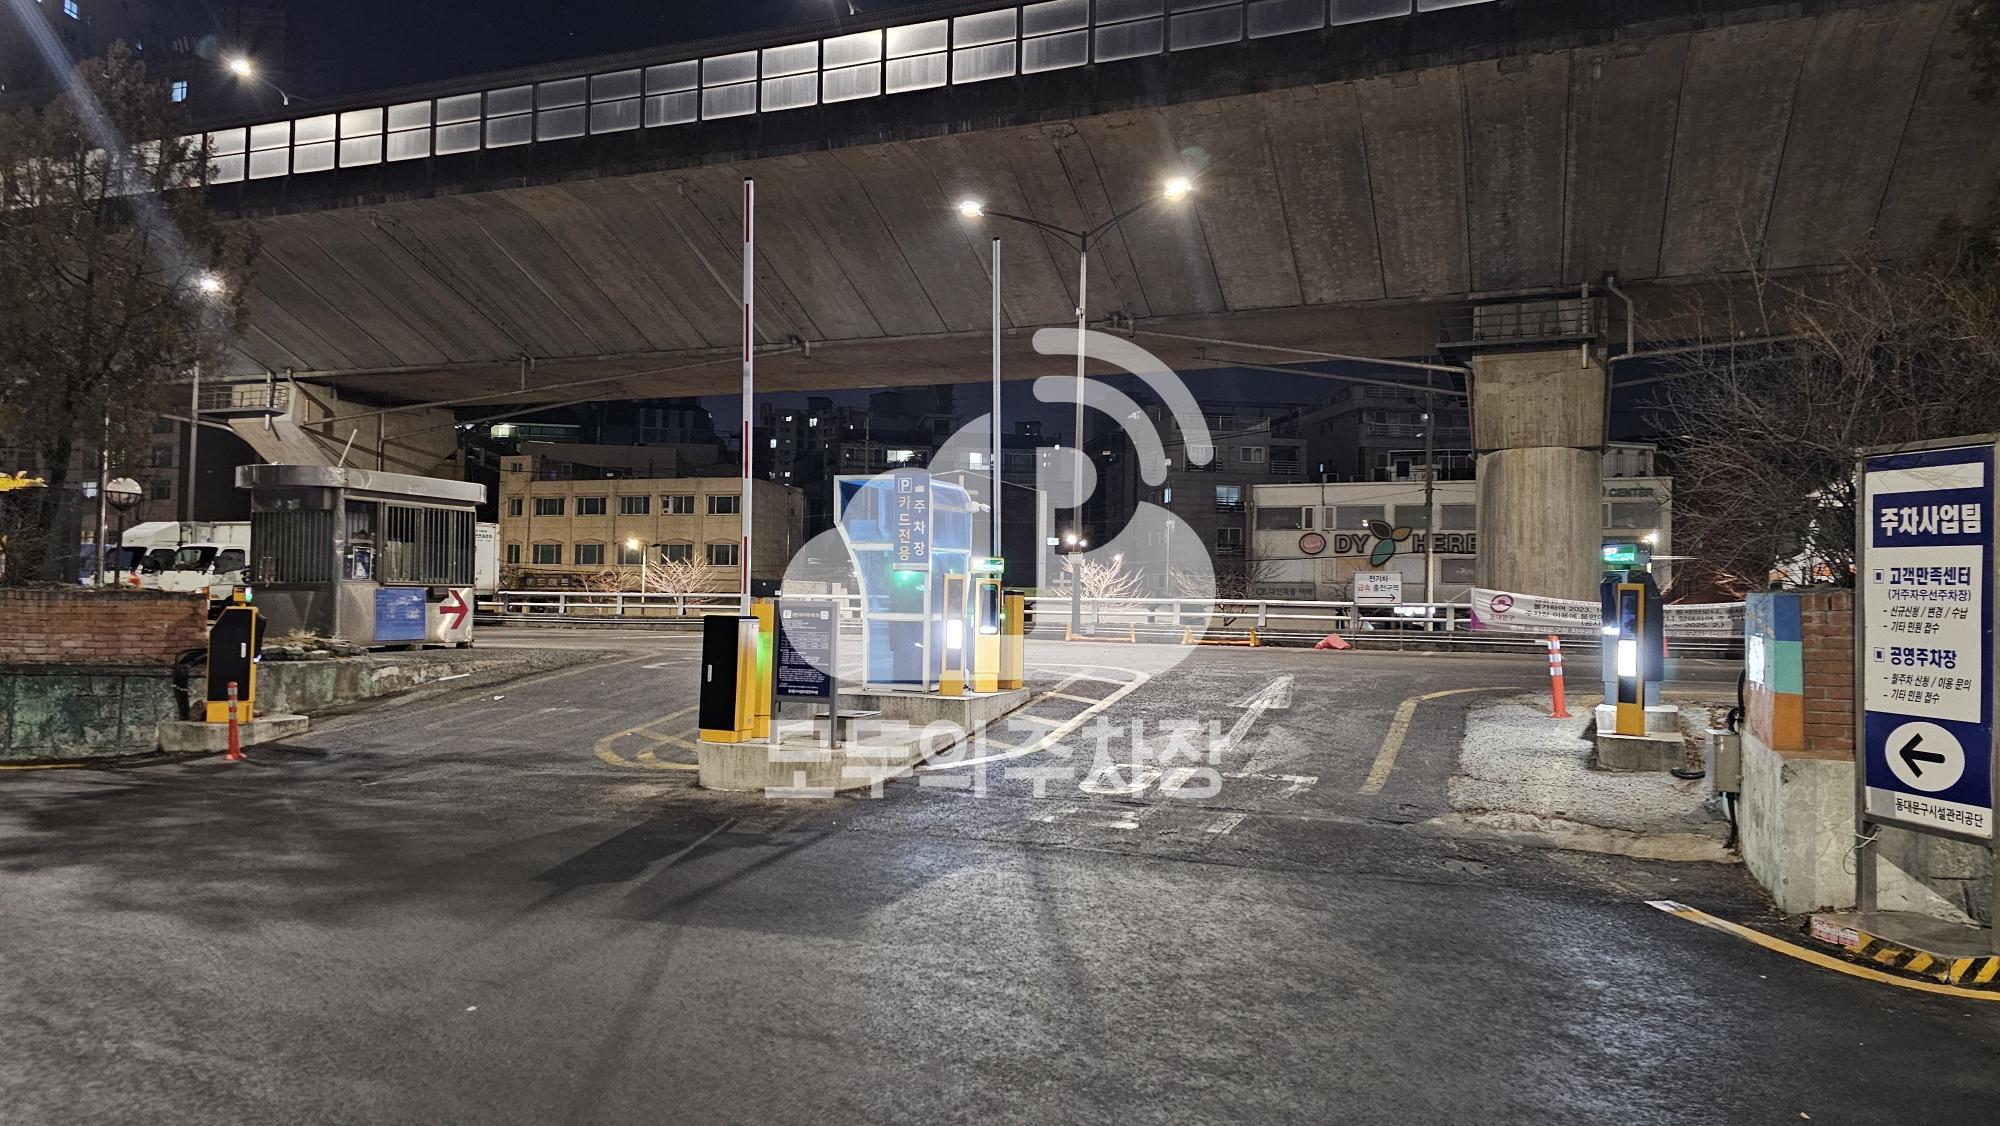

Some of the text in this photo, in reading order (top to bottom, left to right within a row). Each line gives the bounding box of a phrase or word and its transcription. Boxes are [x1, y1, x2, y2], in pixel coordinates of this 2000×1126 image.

[898, 495, 912, 561] 카드전용
[913, 499, 926, 556] 주차장
[1881, 503, 1982, 536] 주차사업팀
[1334, 533, 1370, 554] DY
[1369, 575, 1389, 583] 전기차
[1890, 566, 1971, 586] 고객만족센터
[1373, 584, 1399, 592] 충전구역
[1888, 588, 1971, 602] (거주자우선주차장)
[1890, 605, 1920, 618] 신규신청
[1928, 606, 1944, 619] 변경
[1952, 607, 1969, 619] 수납
[1891, 621, 1940, 634] 기타 민원 접수
[1890, 646, 1957, 669] 공영주차장
[1914, 675, 1930, 687] 신청
[1938, 677, 1954, 690] 이용
[1955, 678, 1972, 691] 문의
[1891, 689, 1940, 704] 기타 민원 접수
[1895, 797, 1984, 828] 동대문구시설관리공단
